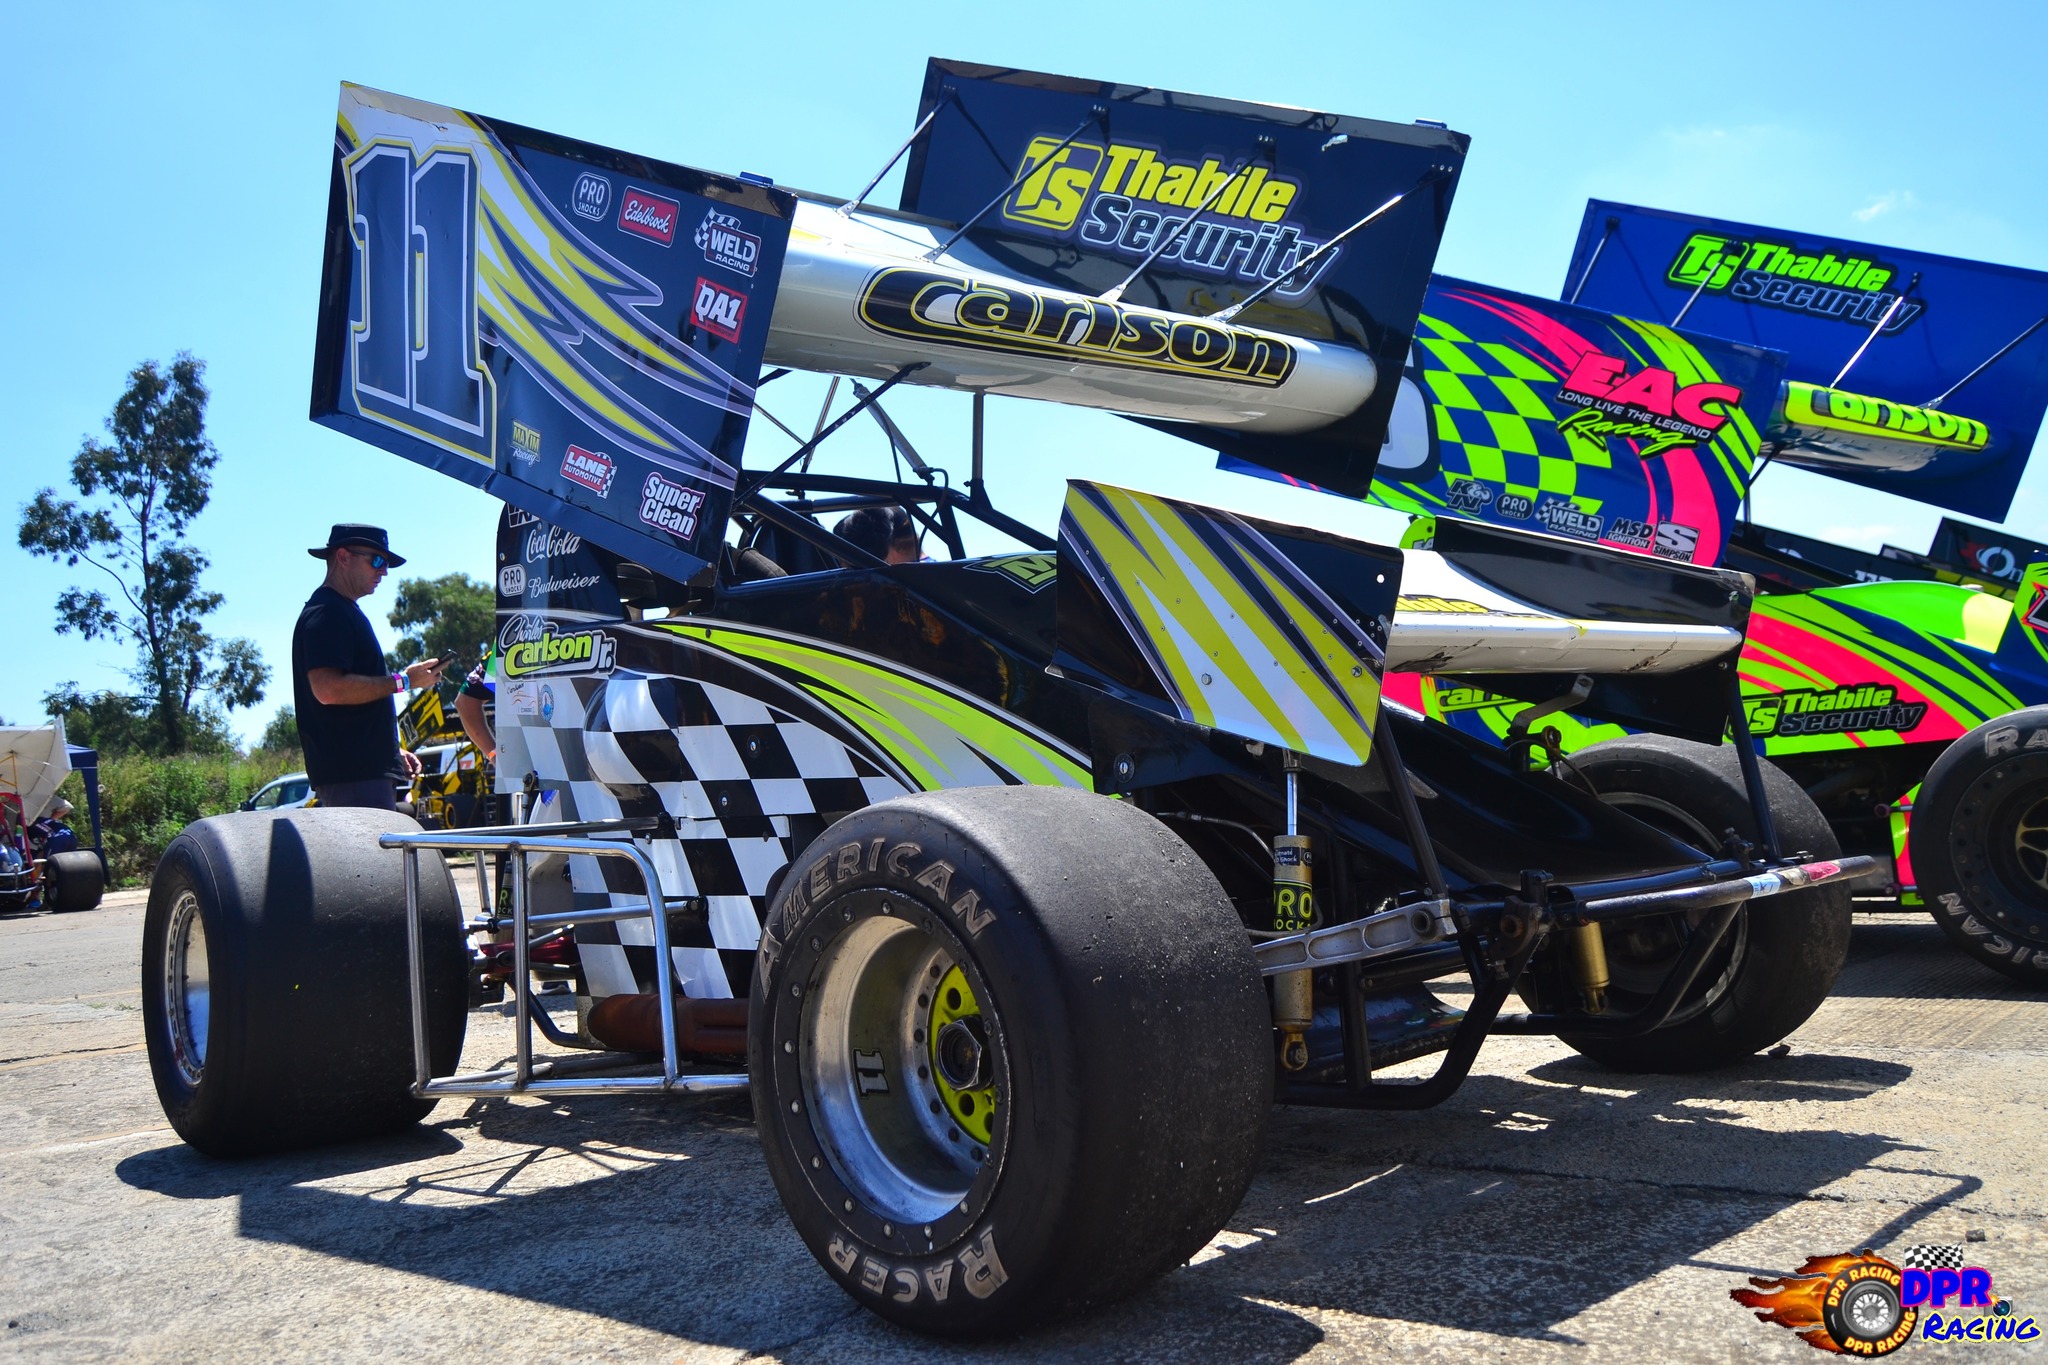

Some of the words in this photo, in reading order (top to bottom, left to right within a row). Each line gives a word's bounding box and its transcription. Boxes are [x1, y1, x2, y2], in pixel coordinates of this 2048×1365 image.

[579, 179, 605, 204] PRO
[1099, 143, 1297, 223] Thabile
[578, 202, 601, 217] SHOCKS
[624, 200, 670, 234] Edelbrock
[710, 229, 757, 263] WELD
[1082, 193, 1340, 296] Security
[715, 254, 750, 272] RACING
[1745, 242, 1892, 292] Thabile
[342, 136, 497, 468] 11
[695, 280, 742, 330] QA1
[1732, 269, 1922, 332] Security
[1563, 350, 1742, 430] EAC
[1557, 389, 1594, 406] LONG
[1594, 399, 1625, 415] LIVE
[1627, 408, 1652, 423] THE
[1655, 416, 1711, 440] LEGEND
[513, 420, 541, 452] MAXIM
[1557, 406, 1697, 456] Racing
[512, 446, 538, 467] Racing
[566, 451, 608, 478] LANE
[564, 465, 603, 486] AUTOMOTIVE
[645, 476, 701, 513] Super
[1501, 496, 1528, 512] PRO
[642, 499, 695, 536] Clean
[1501, 509, 1525, 519] SHOCKS
[1551, 508, 1600, 532] WELD
[1611, 517, 1654, 538] MSD
[1549, 523, 1598, 539] RACING
[1607, 533, 1649, 548] IGNITION
[1653, 545, 1692, 562] SIMPSON
[503, 569, 521, 586] PRO
[528, 573, 600, 598] Budweiser
[1783, 687, 1893, 714] Thabile
[1780, 705, 1925, 734] Security
[1274, 888, 1312, 918] RO
[758, 836, 999, 1001] AMERICAN
[826, 1225, 1010, 1302] RACER
